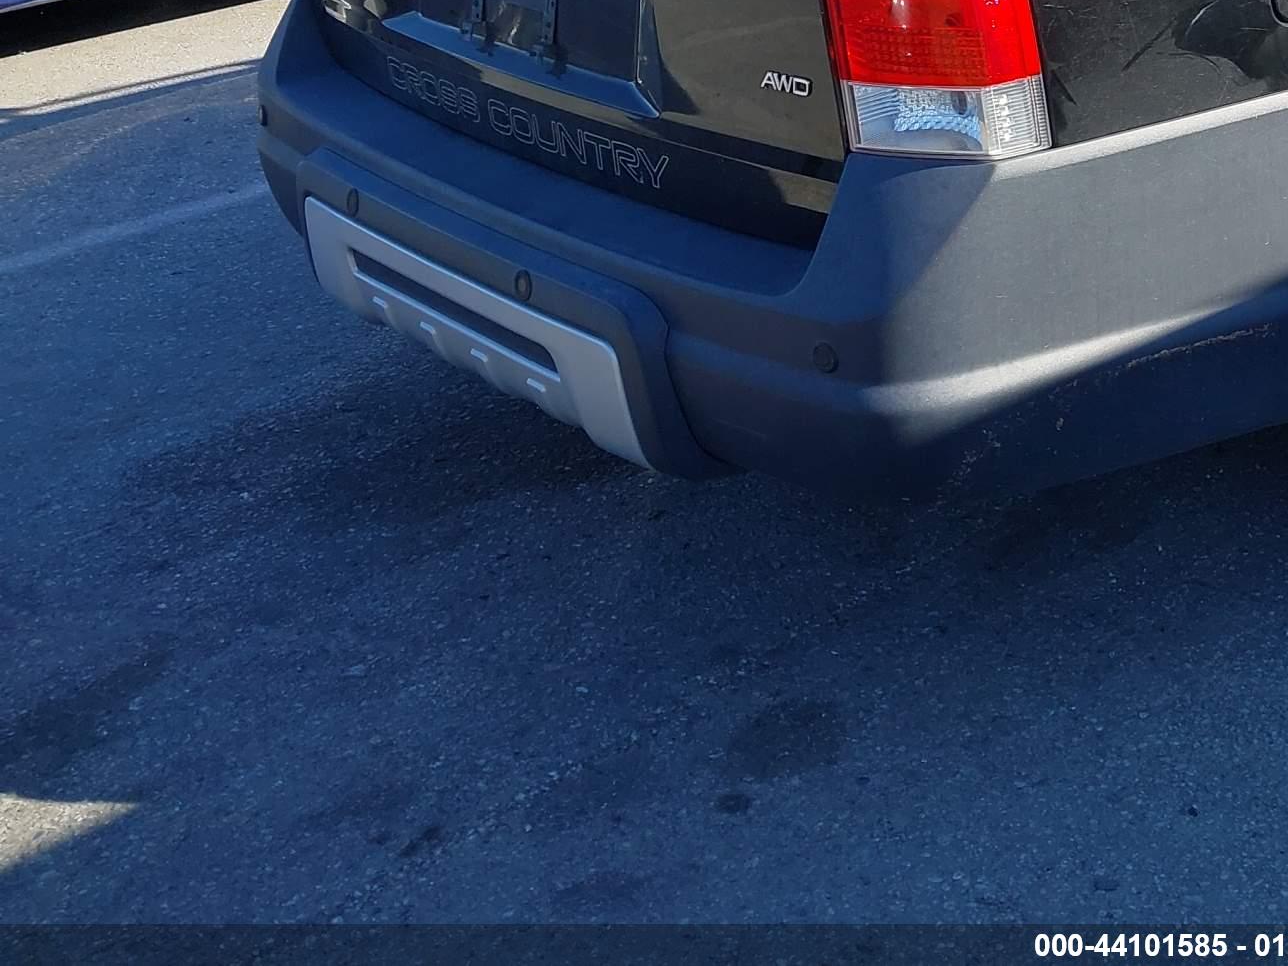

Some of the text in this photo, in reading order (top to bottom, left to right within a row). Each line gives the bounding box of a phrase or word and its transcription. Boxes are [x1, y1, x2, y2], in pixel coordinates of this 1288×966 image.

[386, 55, 669, 188] CROSS COUNTRY
[760, 71, 811, 97] AWD
